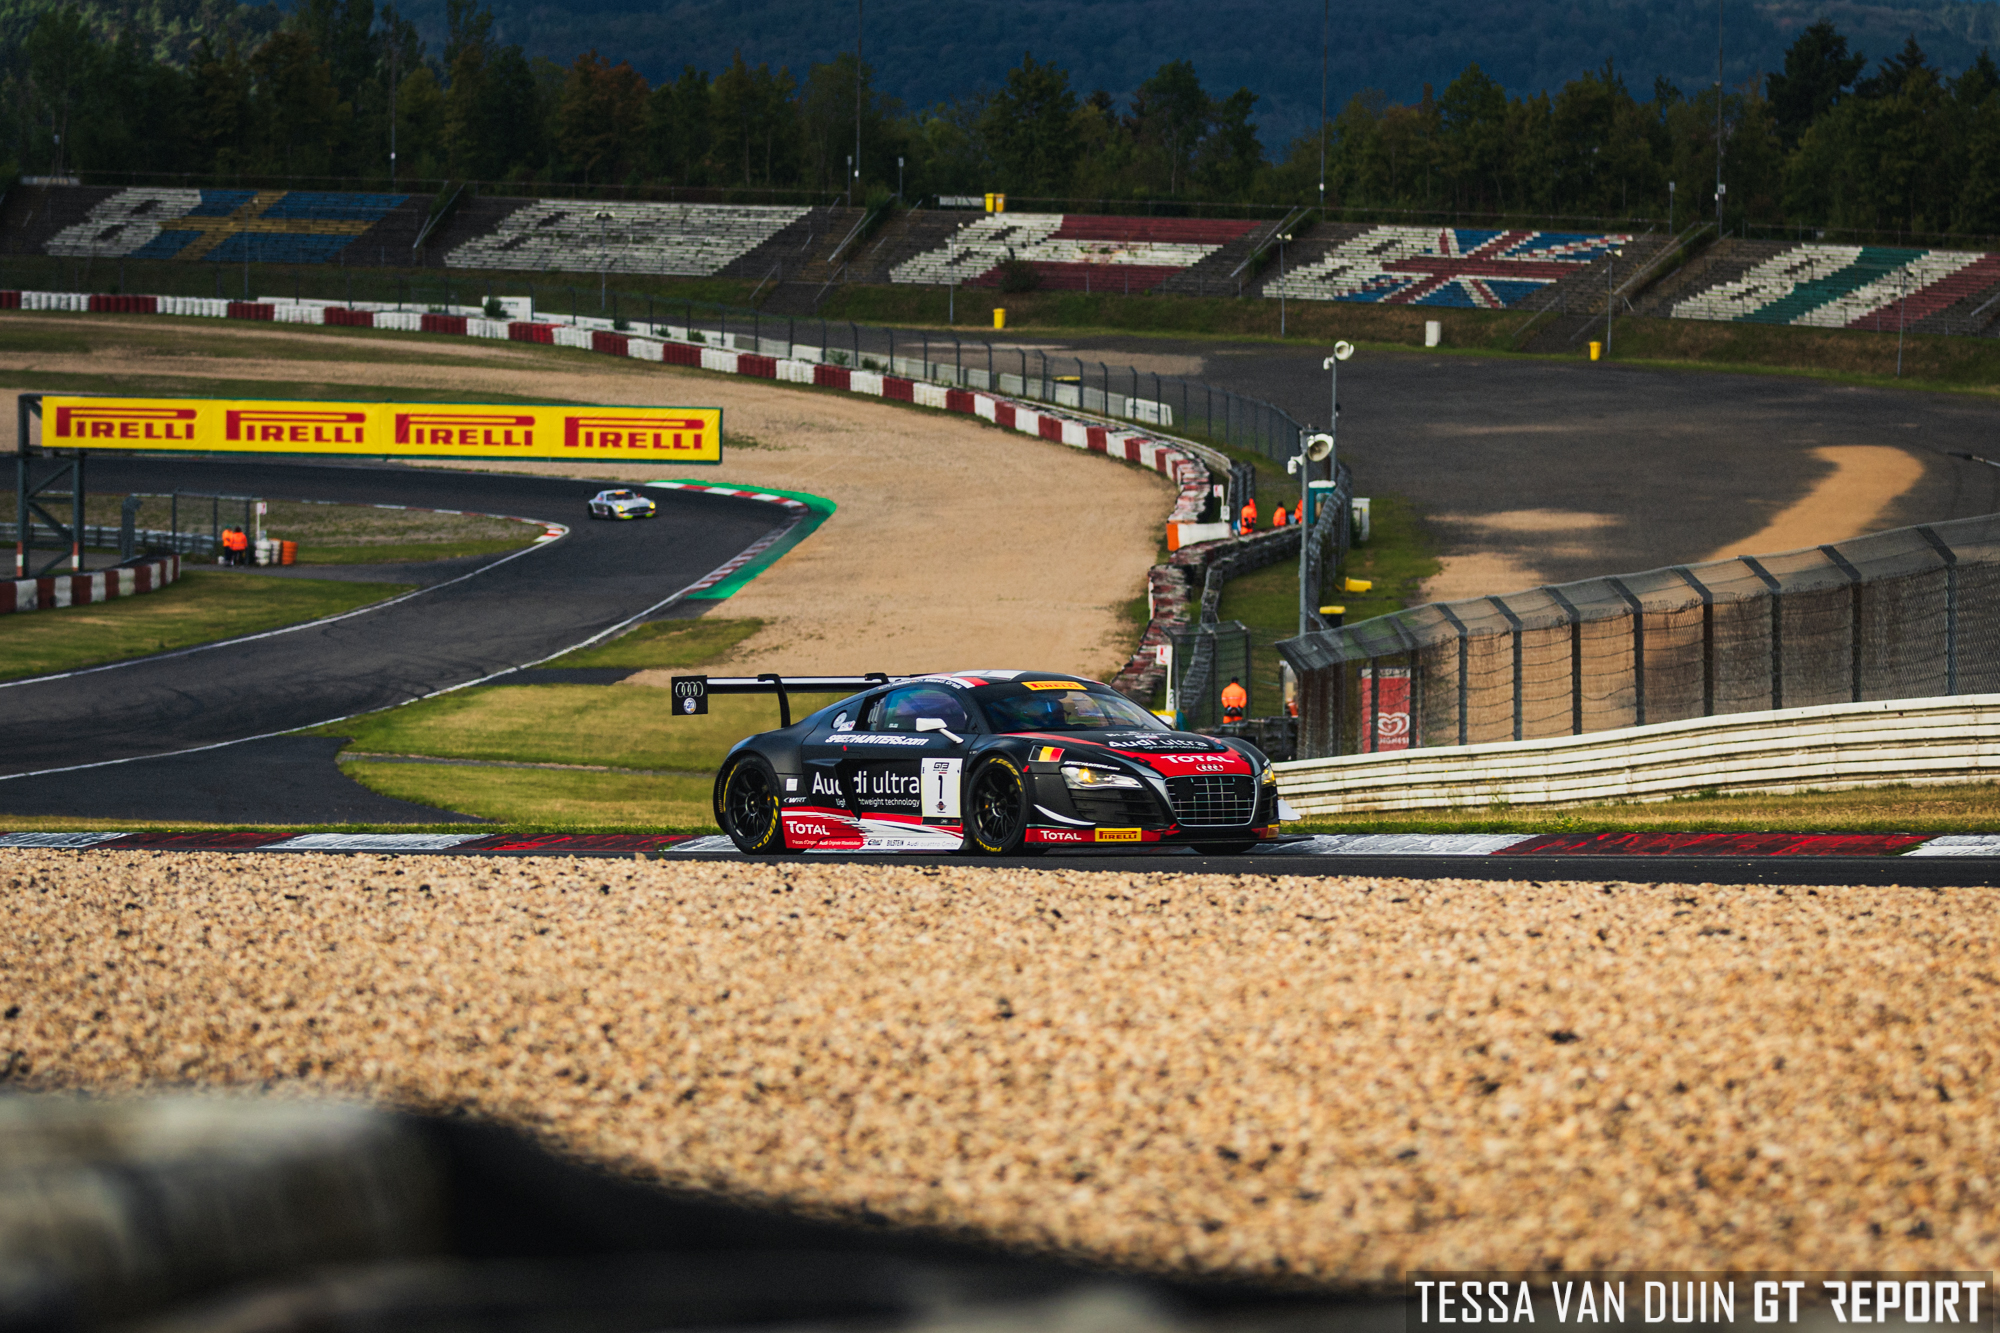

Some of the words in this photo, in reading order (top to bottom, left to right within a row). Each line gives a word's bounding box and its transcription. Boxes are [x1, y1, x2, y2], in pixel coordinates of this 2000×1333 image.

[56, 406, 197, 440] PIRELLI
[226, 409, 366, 444] PIRELLI
[395, 412, 536, 447] PIRELLI
[564, 415, 705, 451] PIRELLI
[1109, 739, 1157, 747] Audi
[1159, 738, 1208, 747] ultra
[1161, 755, 1235, 763] TOTAL
[873, 771, 920, 794] ultra
[938, 775, 943, 800] 1
[885, 798, 920, 808] technology
[786, 821, 830, 835] TOTAL
[1040, 830, 1082, 840] TOTAL
[1099, 831, 1138, 839] PIRELLI
[886, 839, 904, 847] BILSTEIN
